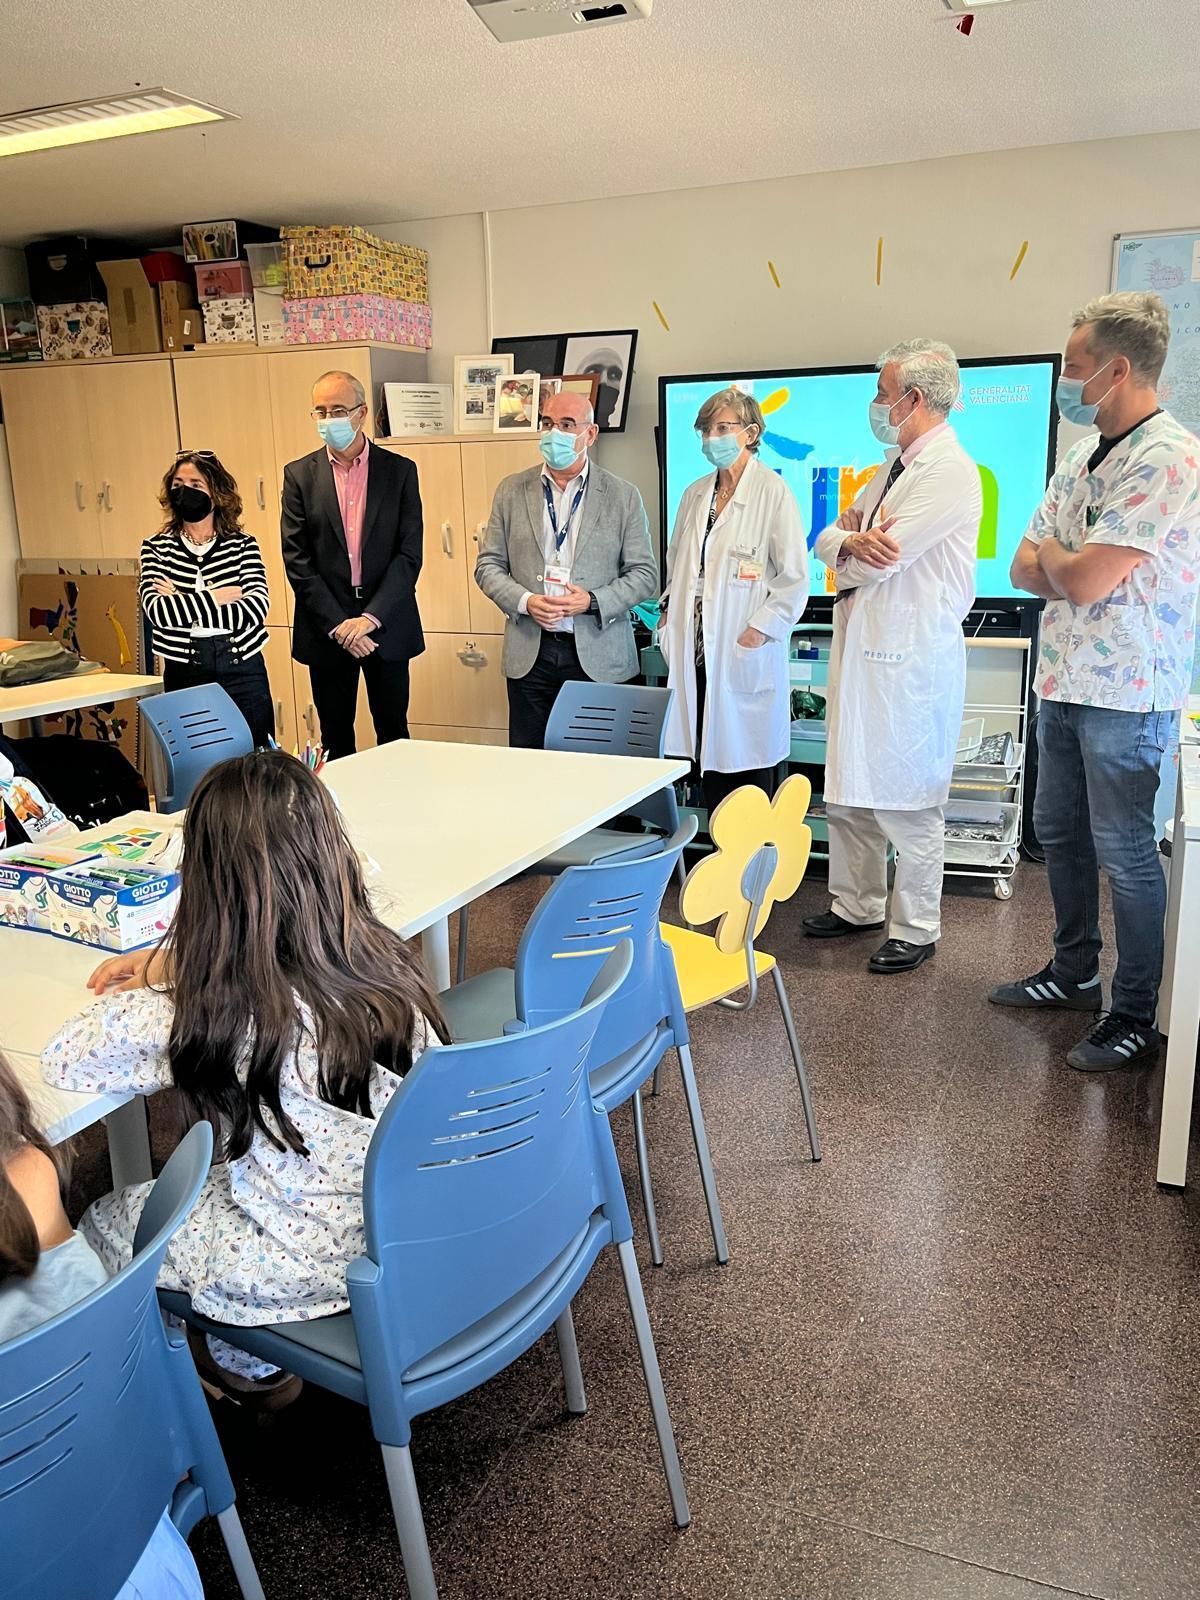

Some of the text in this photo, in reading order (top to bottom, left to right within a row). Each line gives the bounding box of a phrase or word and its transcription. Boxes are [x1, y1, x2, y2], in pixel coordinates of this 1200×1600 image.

[969, 384, 1031, 396] GENERALITAT
[969, 394, 1030, 405] VALENCIANA
[863, 650, 902, 661] MEDICO
[63, 883, 92, 898] GIOTTO
[131, 879, 168, 898] GIOTTO
